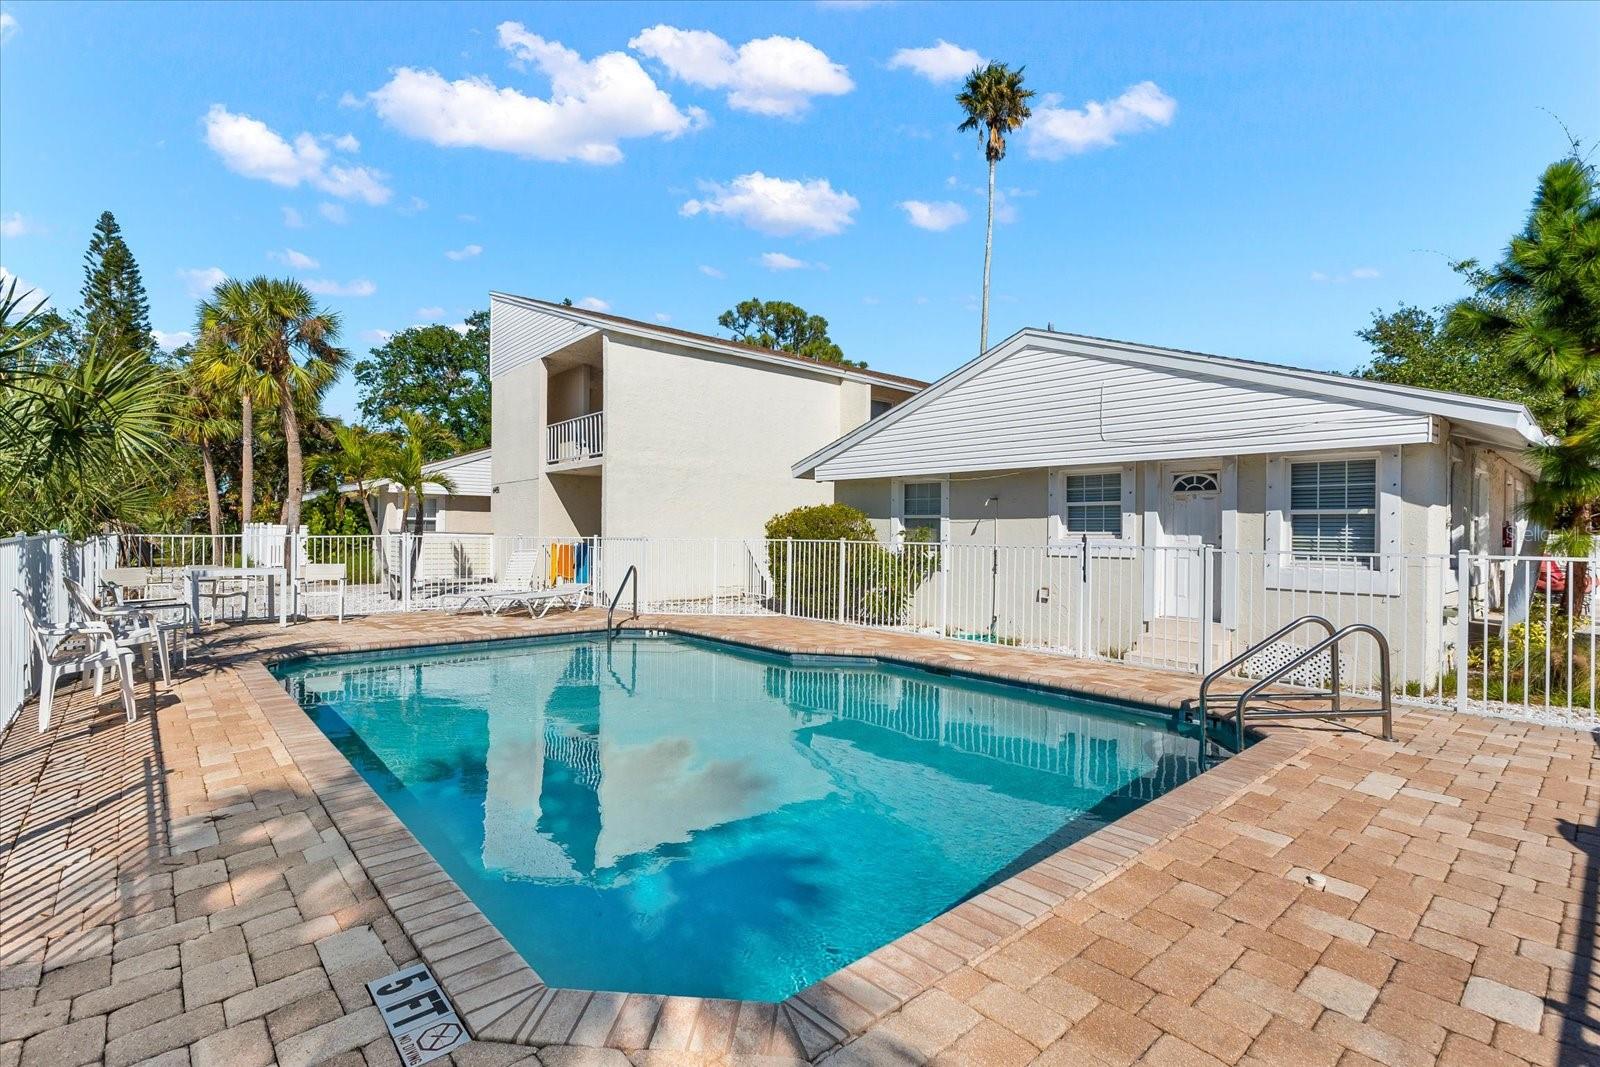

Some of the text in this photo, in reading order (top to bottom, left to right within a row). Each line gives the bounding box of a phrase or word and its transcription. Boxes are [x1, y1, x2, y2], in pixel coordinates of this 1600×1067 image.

[376, 970, 450, 1029] 5 FT
[399, 1033, 422, 1066] NO DIVING
